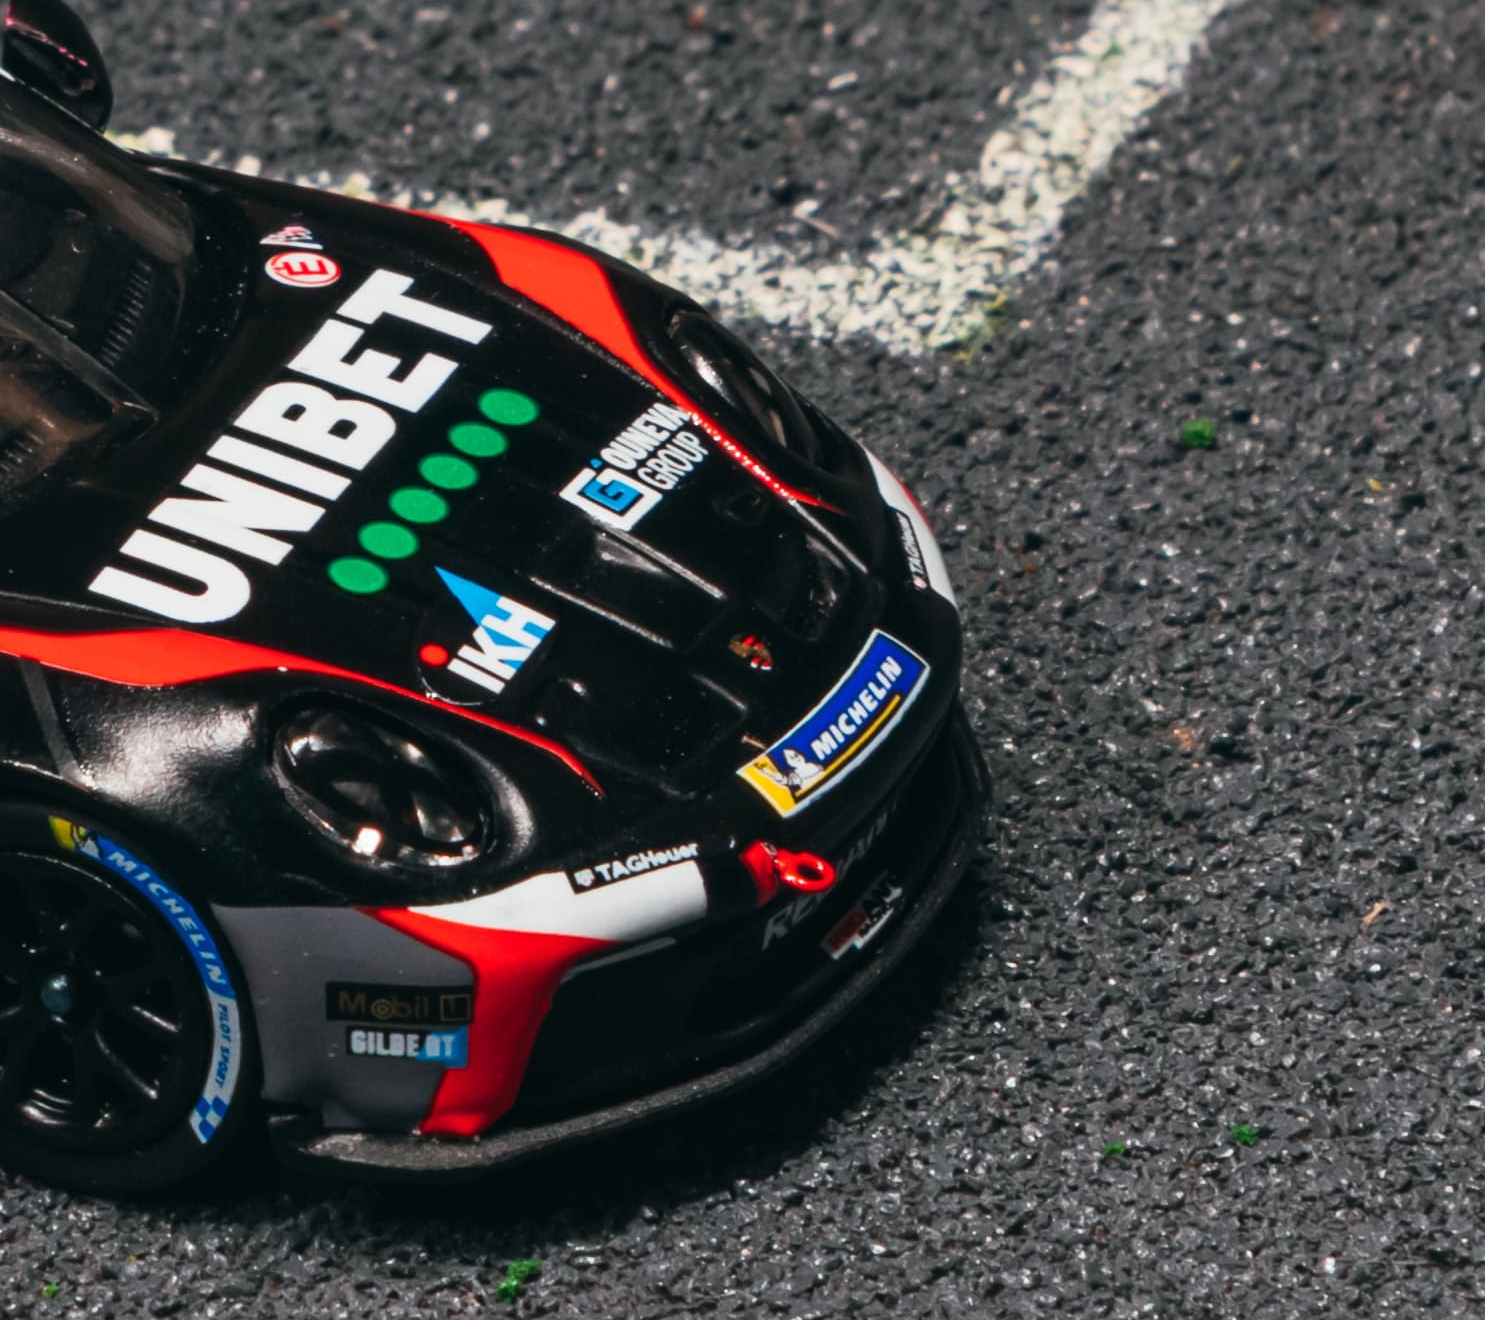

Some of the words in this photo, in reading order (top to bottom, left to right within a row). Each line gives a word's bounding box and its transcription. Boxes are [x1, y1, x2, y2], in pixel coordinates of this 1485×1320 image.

[88, 269, 493, 623] UNIBET
[637, 431, 709, 491] GROUP
[810, 655, 903, 761] MICHELIN
[107, 850, 228, 985] MICHELIN
